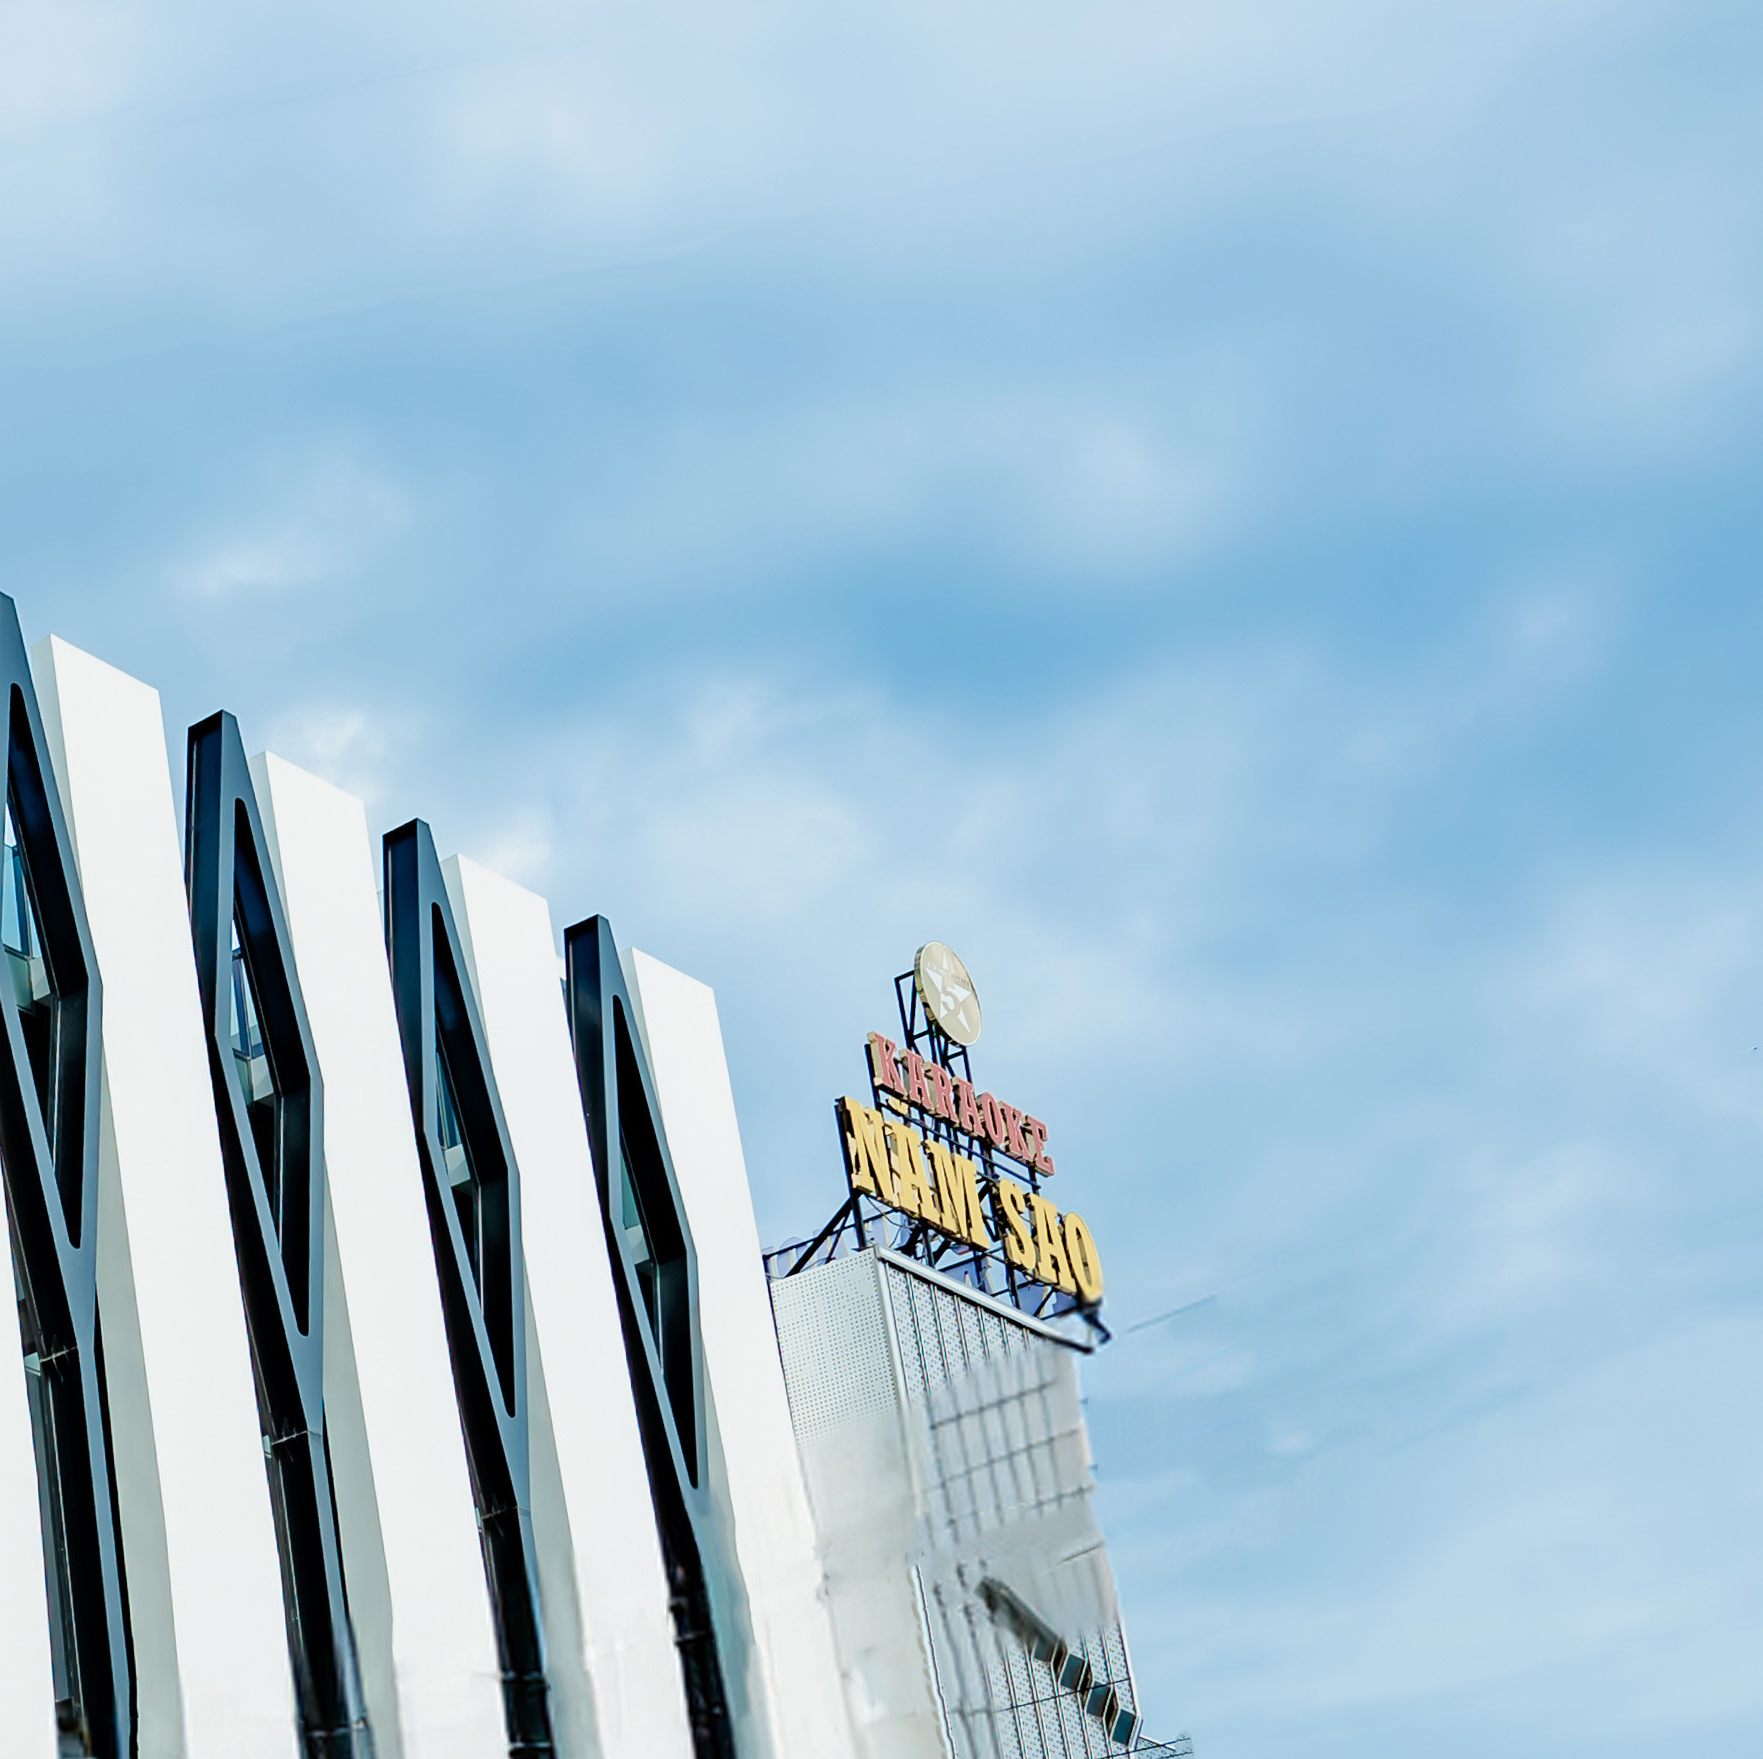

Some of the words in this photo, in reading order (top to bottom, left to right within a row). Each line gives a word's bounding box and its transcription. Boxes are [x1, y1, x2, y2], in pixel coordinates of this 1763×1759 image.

[867, 1031, 1055, 1177] KARAOKE
[835, 1095, 991, 1251] NĂM
[996, 1178, 1104, 1303] SAO
